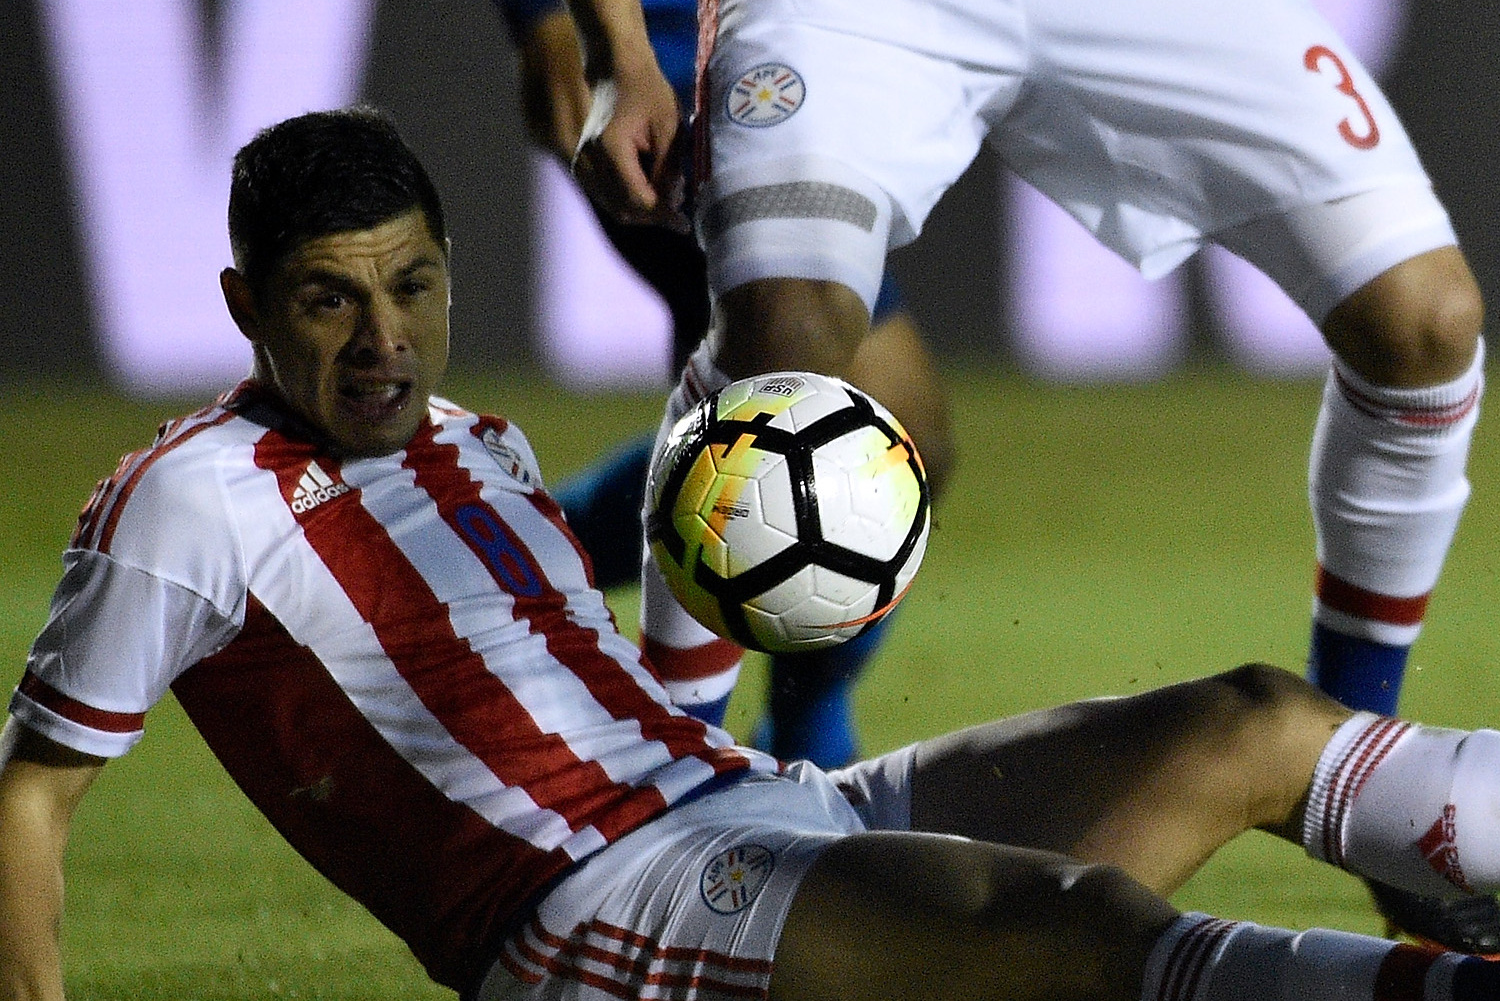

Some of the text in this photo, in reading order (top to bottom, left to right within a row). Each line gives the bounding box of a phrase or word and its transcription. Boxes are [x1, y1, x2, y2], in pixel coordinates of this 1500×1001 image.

[1303, 45, 1380, 151] 3
[763, 384, 793, 396] USA
[291, 483, 350, 514] adidas
[456, 504, 542, 597] 8
